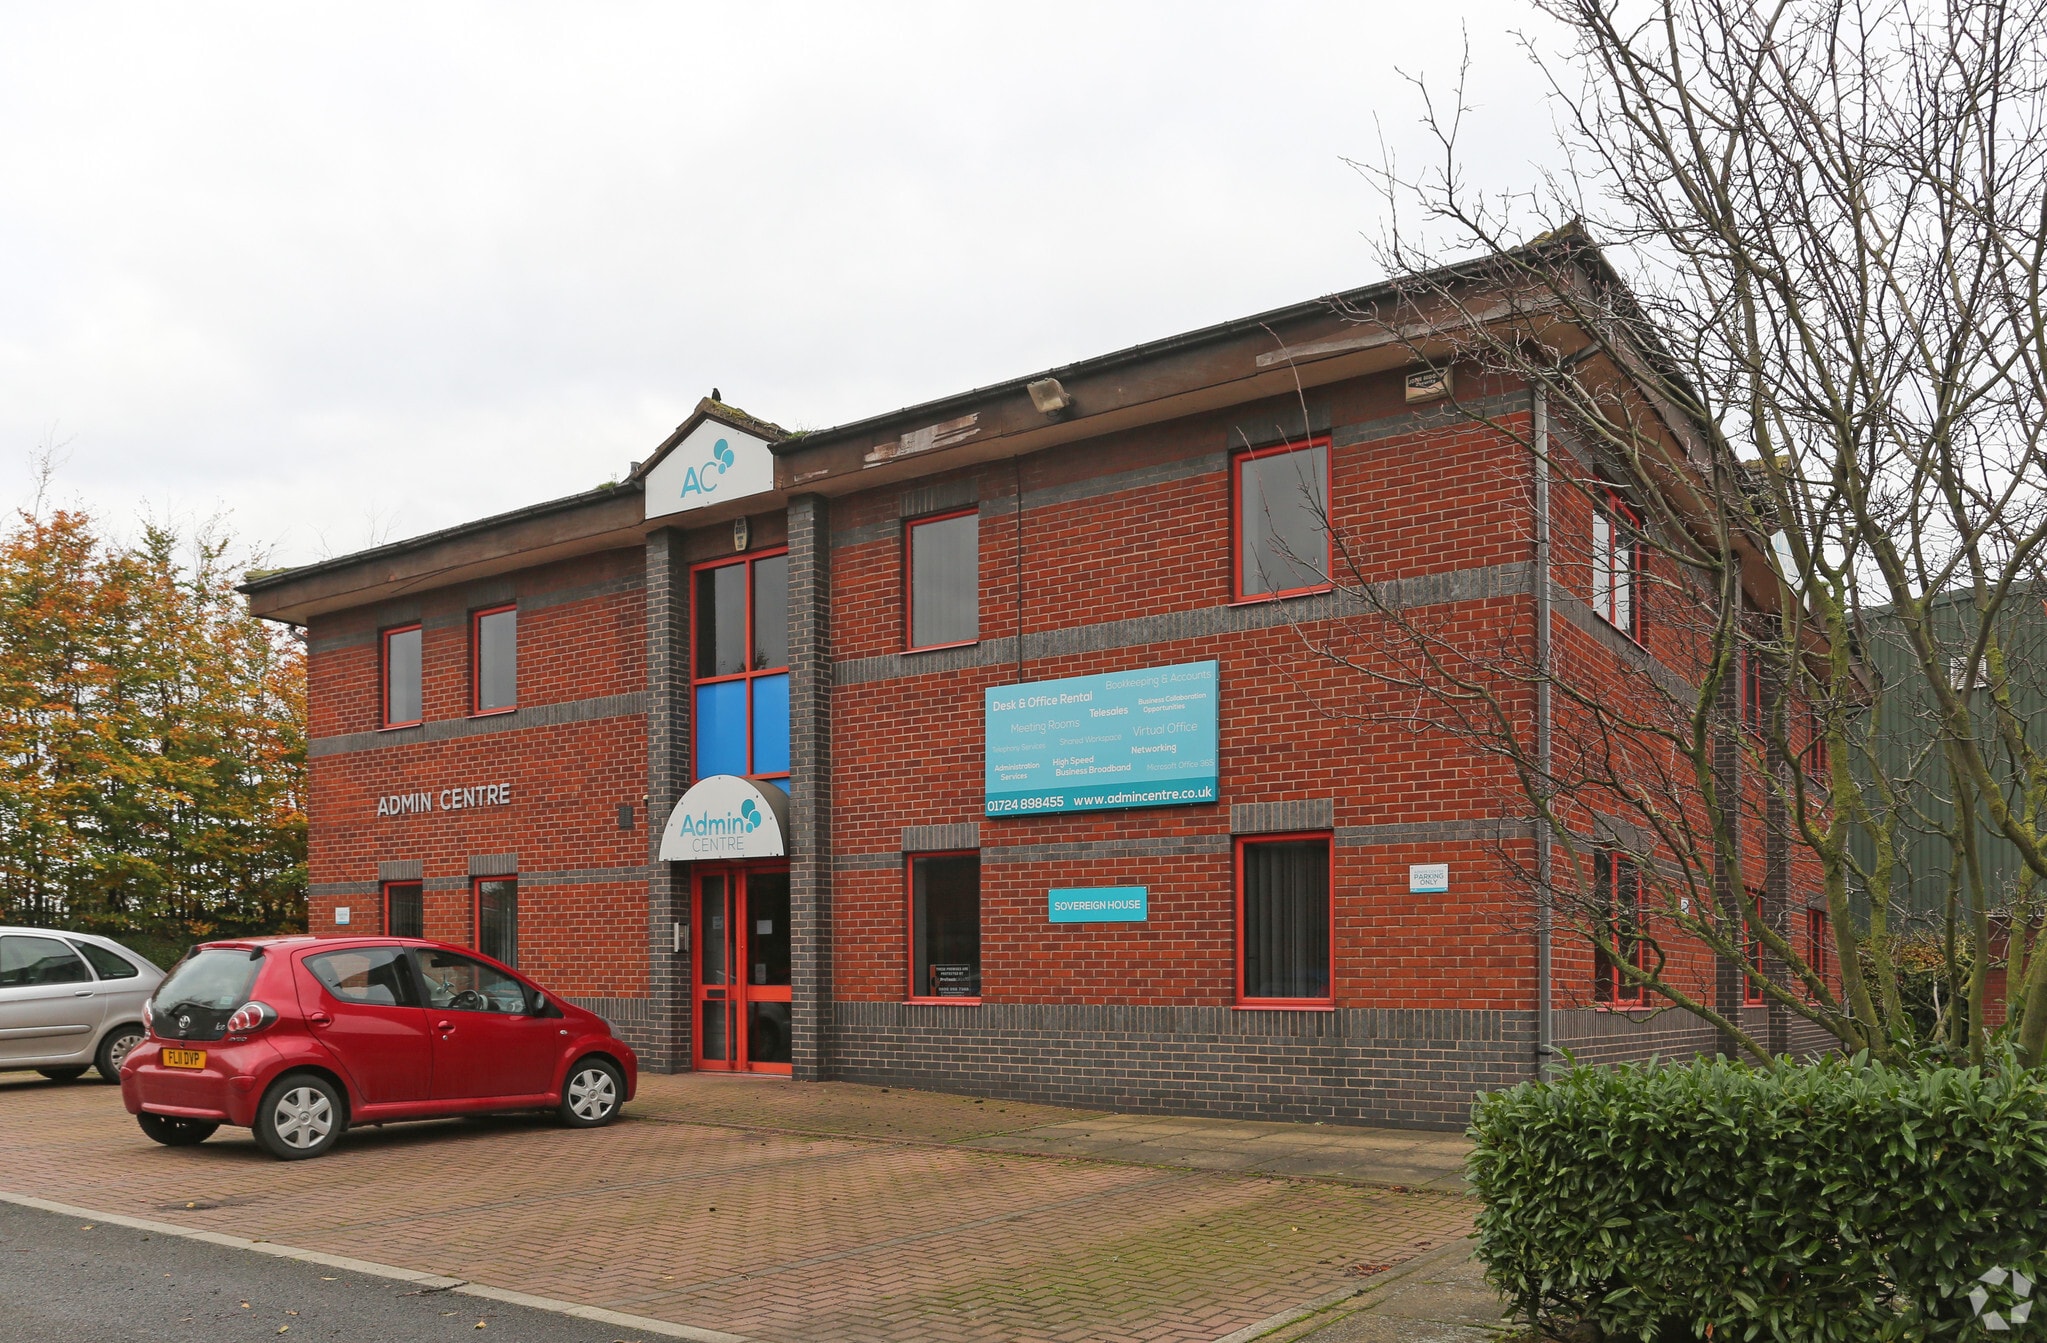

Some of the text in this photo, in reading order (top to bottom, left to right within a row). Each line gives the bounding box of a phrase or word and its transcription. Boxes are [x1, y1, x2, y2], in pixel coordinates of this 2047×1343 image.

[680, 461, 717, 498] AC
[1105, 671, 1212, 690] Bookkeeping & Accounts
[993, 690, 1093, 712] Desk & Office Rental
[1138, 692, 1207, 705] Business Collaboration
[1089, 706, 1129, 718] Telesales
[1143, 703, 1186, 714] Opportunities
[1011, 719, 1081, 735] Meeting Rooms
[1133, 721, 1198, 737] Virtual Office
[1059, 733, 1122, 746] Shared Workspace
[1021, 743, 1046, 751] Services
[1131, 743, 1177, 755] Networking
[994, 762, 1040, 772] Administration
[1052, 755, 1095, 769] High Speed
[1146, 762, 1177, 771] Microsoft
[1178, 760, 1198, 769] Office
[1000, 772, 1028, 781] Services
[1056, 763, 1132, 777] Business Broadband
[377, 783, 511, 817] ADMIN CENTRE
[987, 785, 1212, 812] 01724 898455 www.admincentre.co.uk
[680, 810, 744, 837] Admin
[692, 836, 744, 852] CENTRE
[1054, 900, 1141, 911] SOVEREIGN HOUSE
[184, 1051, 200, 1066] DVP
